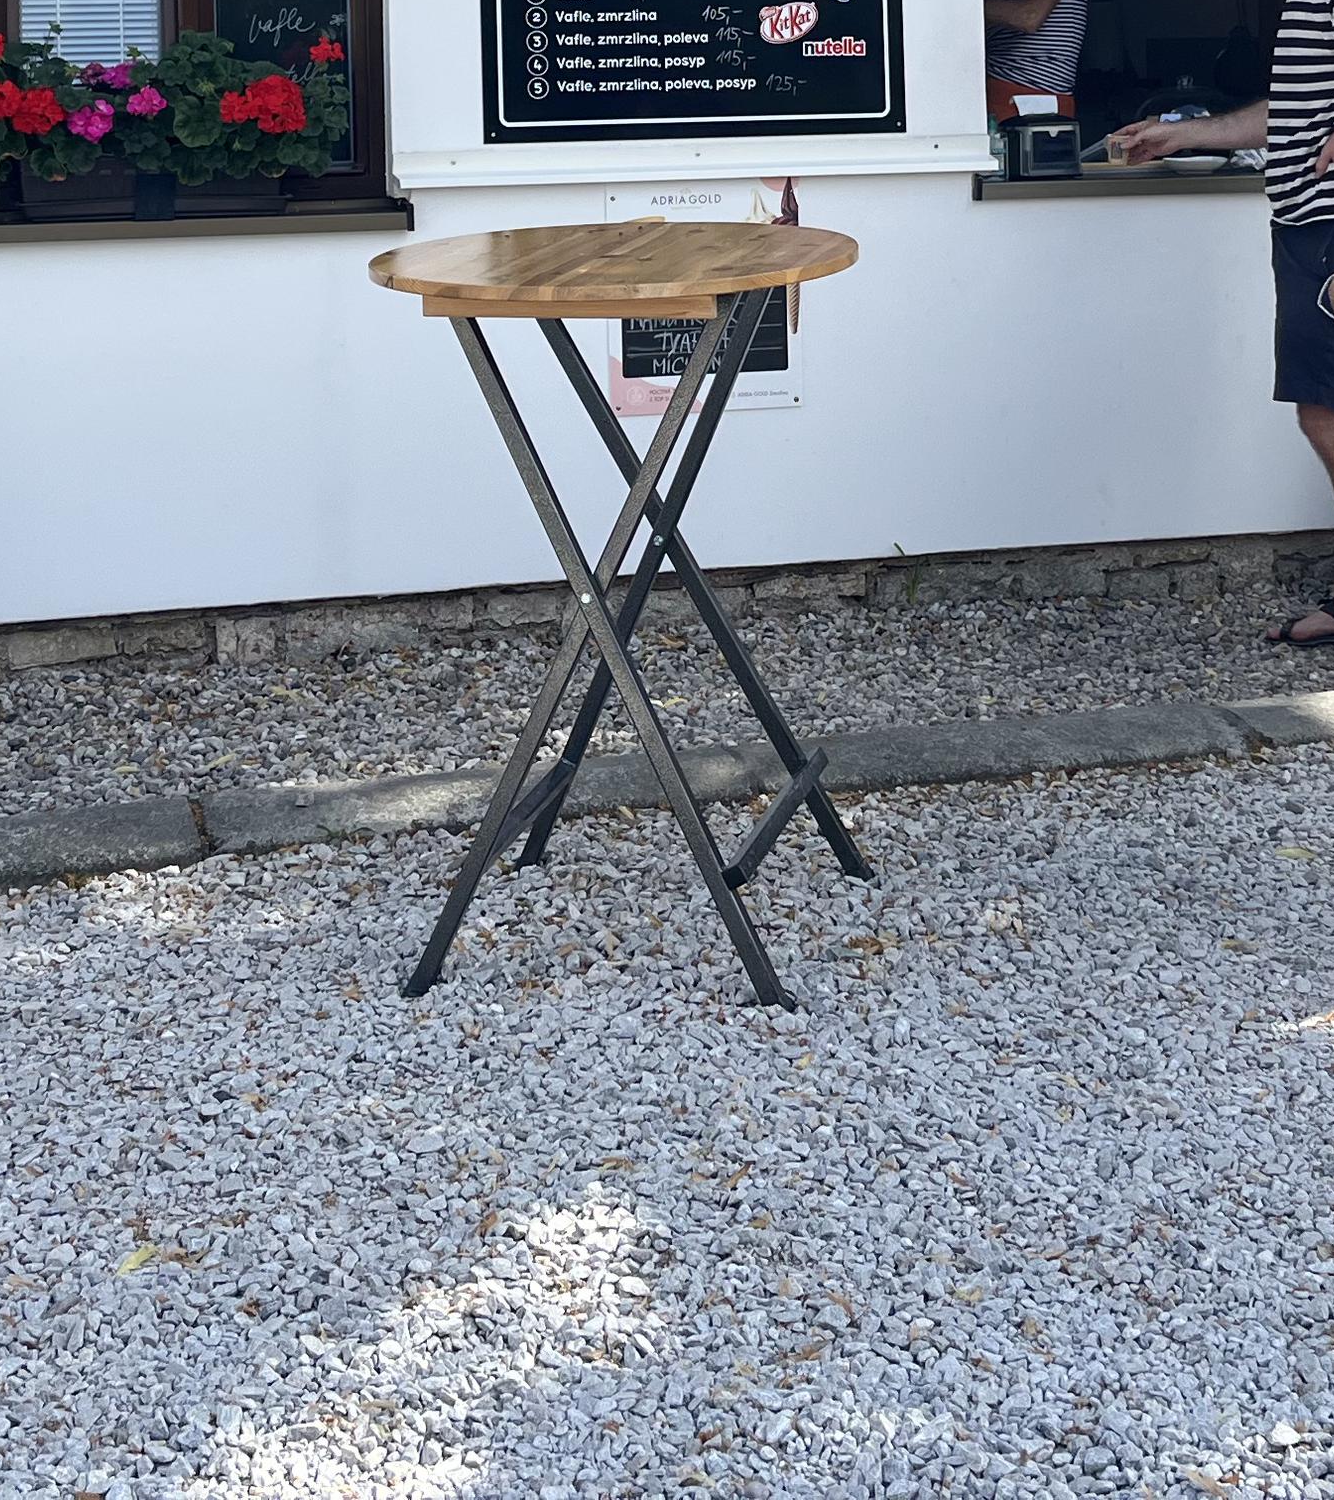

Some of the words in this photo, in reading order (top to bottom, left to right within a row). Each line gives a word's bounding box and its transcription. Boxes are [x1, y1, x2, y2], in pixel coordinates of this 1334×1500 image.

[555, 11, 594, 23] Vafle,
[598, 10, 657, 22] zmrzlina
[770, 5, 811, 39] KitKat
[249, 8, 316, 46] vafle
[556, 34, 595, 47] Vafle,
[598, 33, 661, 47] zmrzlina,
[664, 32, 709, 45] poleva
[804, 37, 865, 55] nutella
[557, 57, 595, 70] Vafle,
[598, 55, 661, 69] zmrzlina,
[665, 57, 705, 69] posyp
[557, 80, 596, 93] Vafle,
[599, 79, 662, 92] zmrzlina,
[666, 79, 713, 91] poleva,
[716, 78, 757, 91] posyp
[651, 196, 686, 205] ADRIA
[689, 194, 721, 204] GOLD
